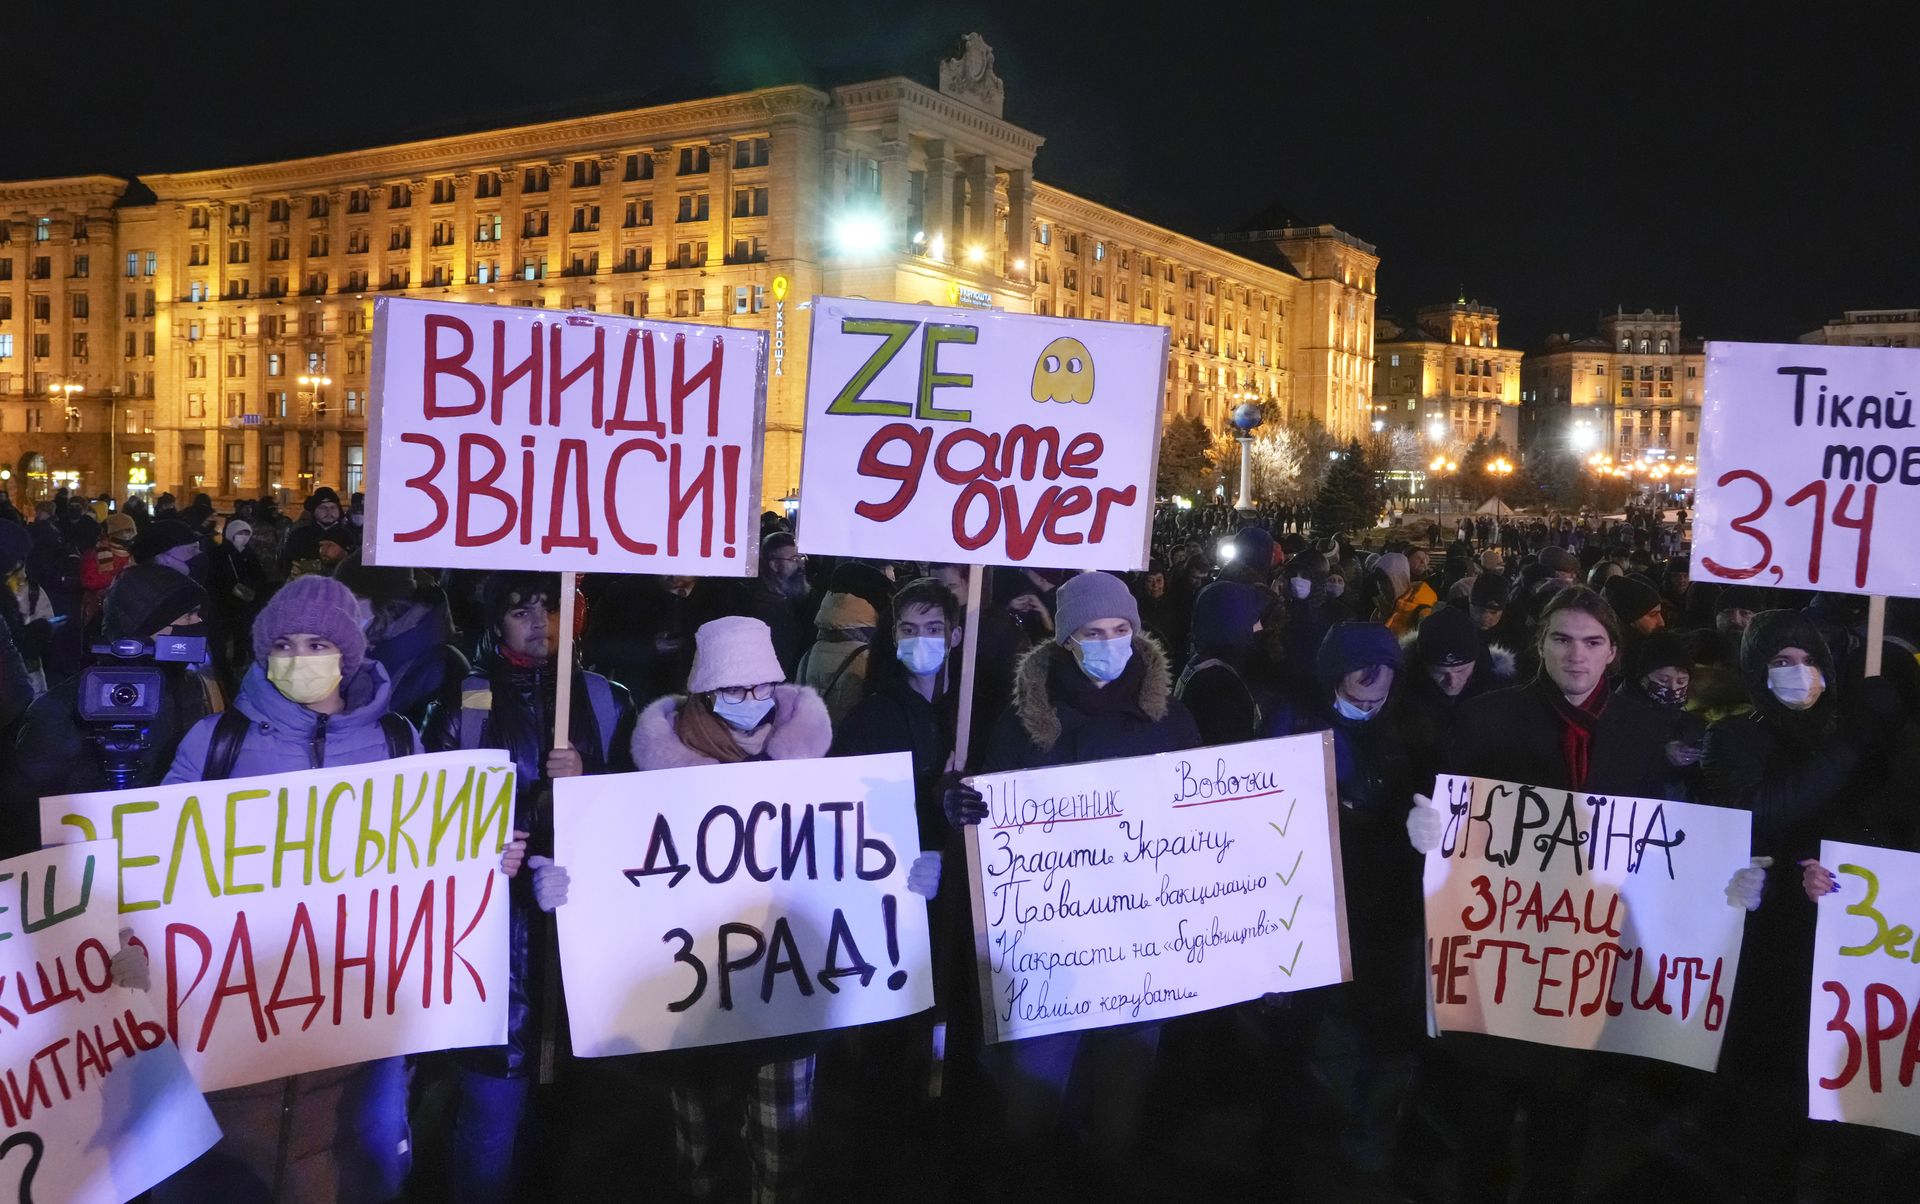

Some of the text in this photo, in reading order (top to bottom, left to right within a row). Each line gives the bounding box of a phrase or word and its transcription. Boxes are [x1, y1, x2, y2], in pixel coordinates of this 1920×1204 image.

[423, 313, 724, 439] ВИЙДИ
[775, 302, 784, 376] УКРПОШТА
[825, 317, 979, 422] ZE
[854, 423, 1104, 522] game
[1701, 469, 1878, 588] 3,14
[1173, 758, 1278, 802] Вовочки
[1441, 778, 1686, 880] УКРАЇНА
[622, 801, 896, 888] ДОСИТЬ
[988, 820, 1236, 892] Зрадити Україну
[662, 894, 908, 1012] ЗРАД!
[991, 879, 1151, 933] Провалити
[993, 930, 1125, 978] Накрасти
[1132, 942, 1160, 957] на
[1461, 875, 1622, 937] ЗРАДИ
[1838, 863, 1920, 964] Зе
[128, 868, 497, 1053] РАДНИК
